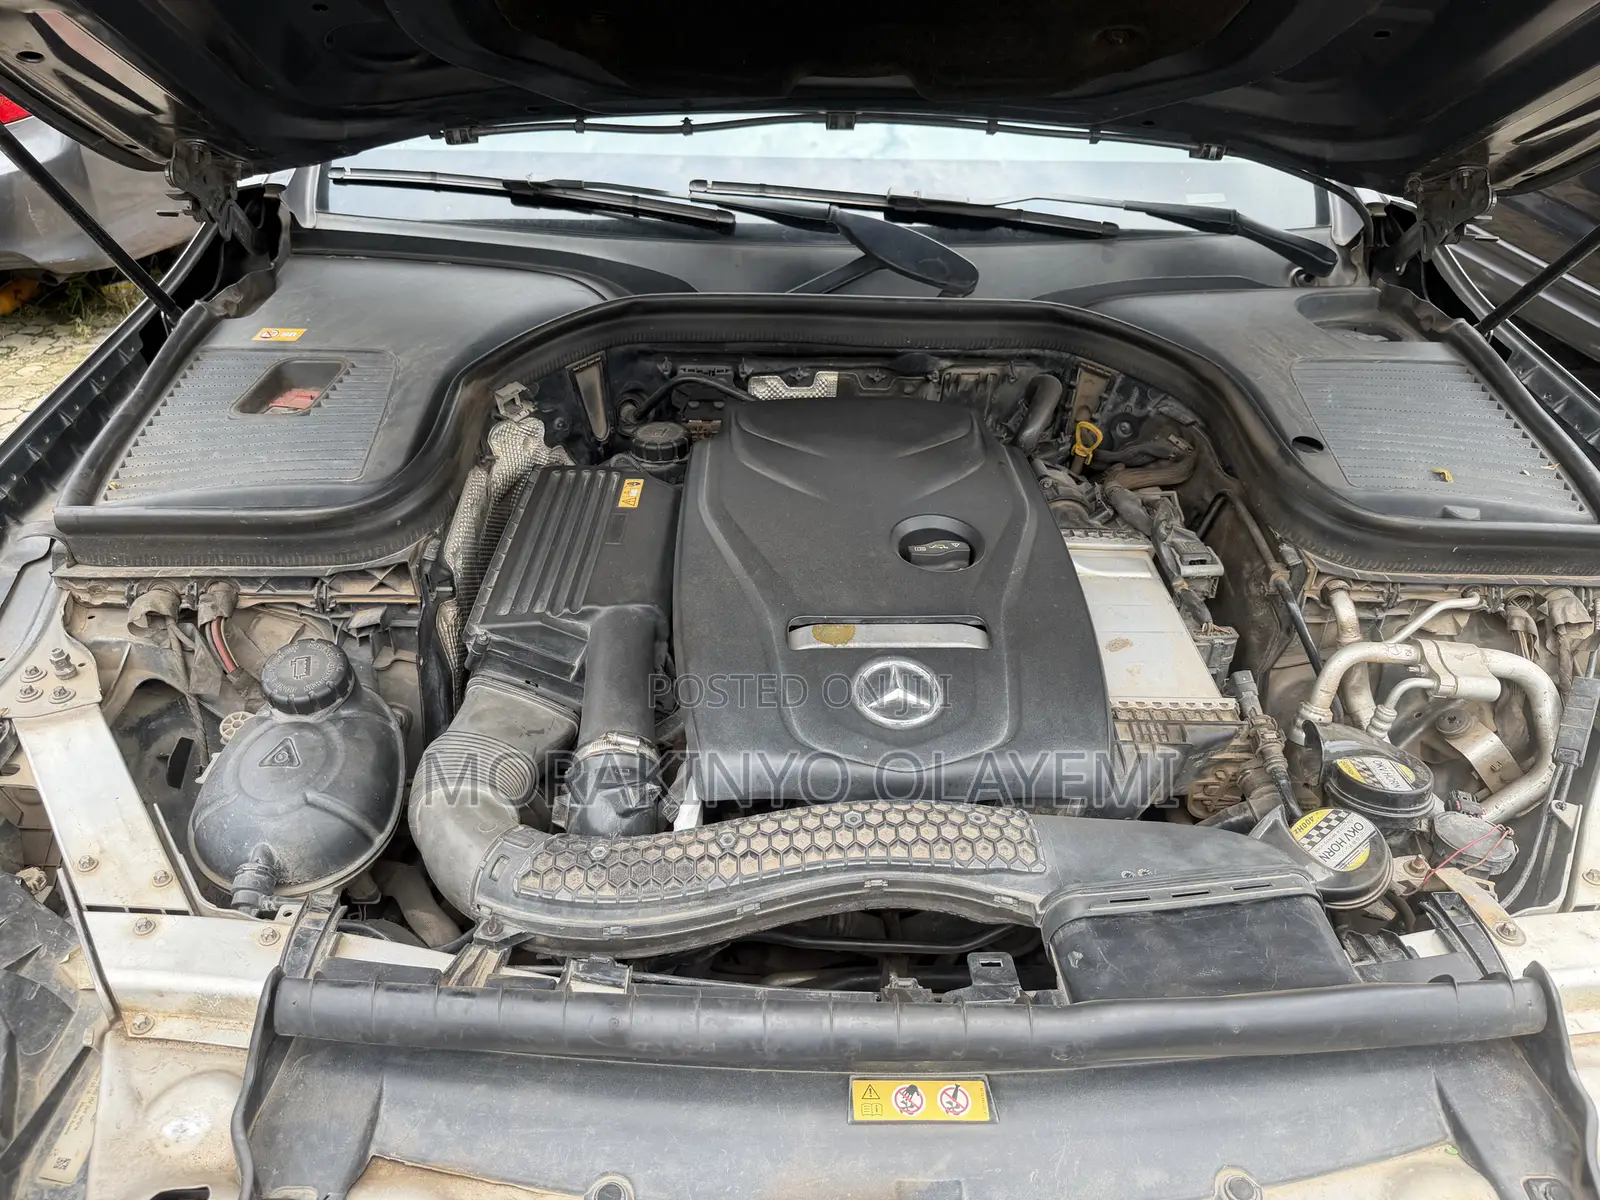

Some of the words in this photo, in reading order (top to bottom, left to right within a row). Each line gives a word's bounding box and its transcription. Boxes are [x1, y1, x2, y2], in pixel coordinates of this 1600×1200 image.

[1294, 815, 1314, 835] 400Hz
[1344, 822, 1364, 842] OKV
[1319, 837, 1347, 862] HORN
